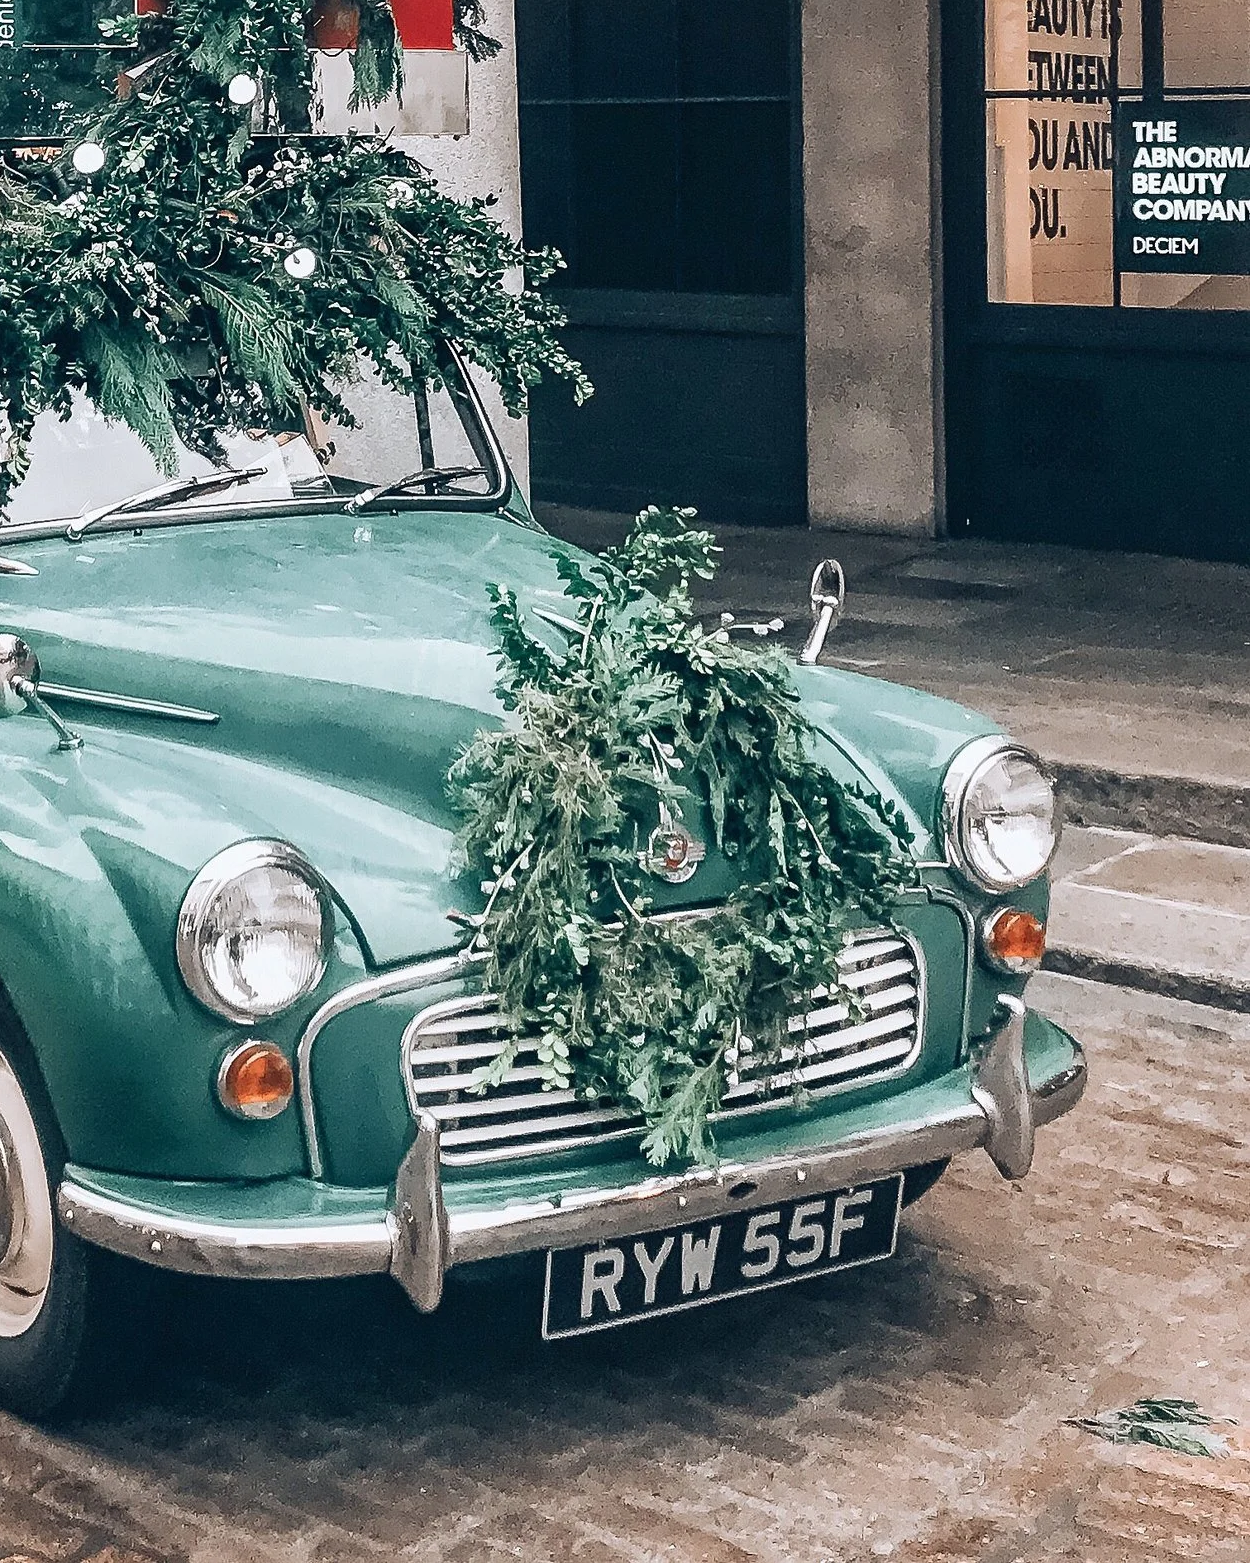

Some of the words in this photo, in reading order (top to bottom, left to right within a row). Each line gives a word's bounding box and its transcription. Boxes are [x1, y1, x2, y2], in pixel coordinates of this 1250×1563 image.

[1028, 50, 1111, 105] TWEEN
[1132, 121, 1177, 142] THE
[1132, 172, 1227, 195] BEAUTY
[1132, 236, 1199, 255] DECIEM
[580, 1225, 722, 1319] RYW
[740, 1189, 873, 1278] 55F
